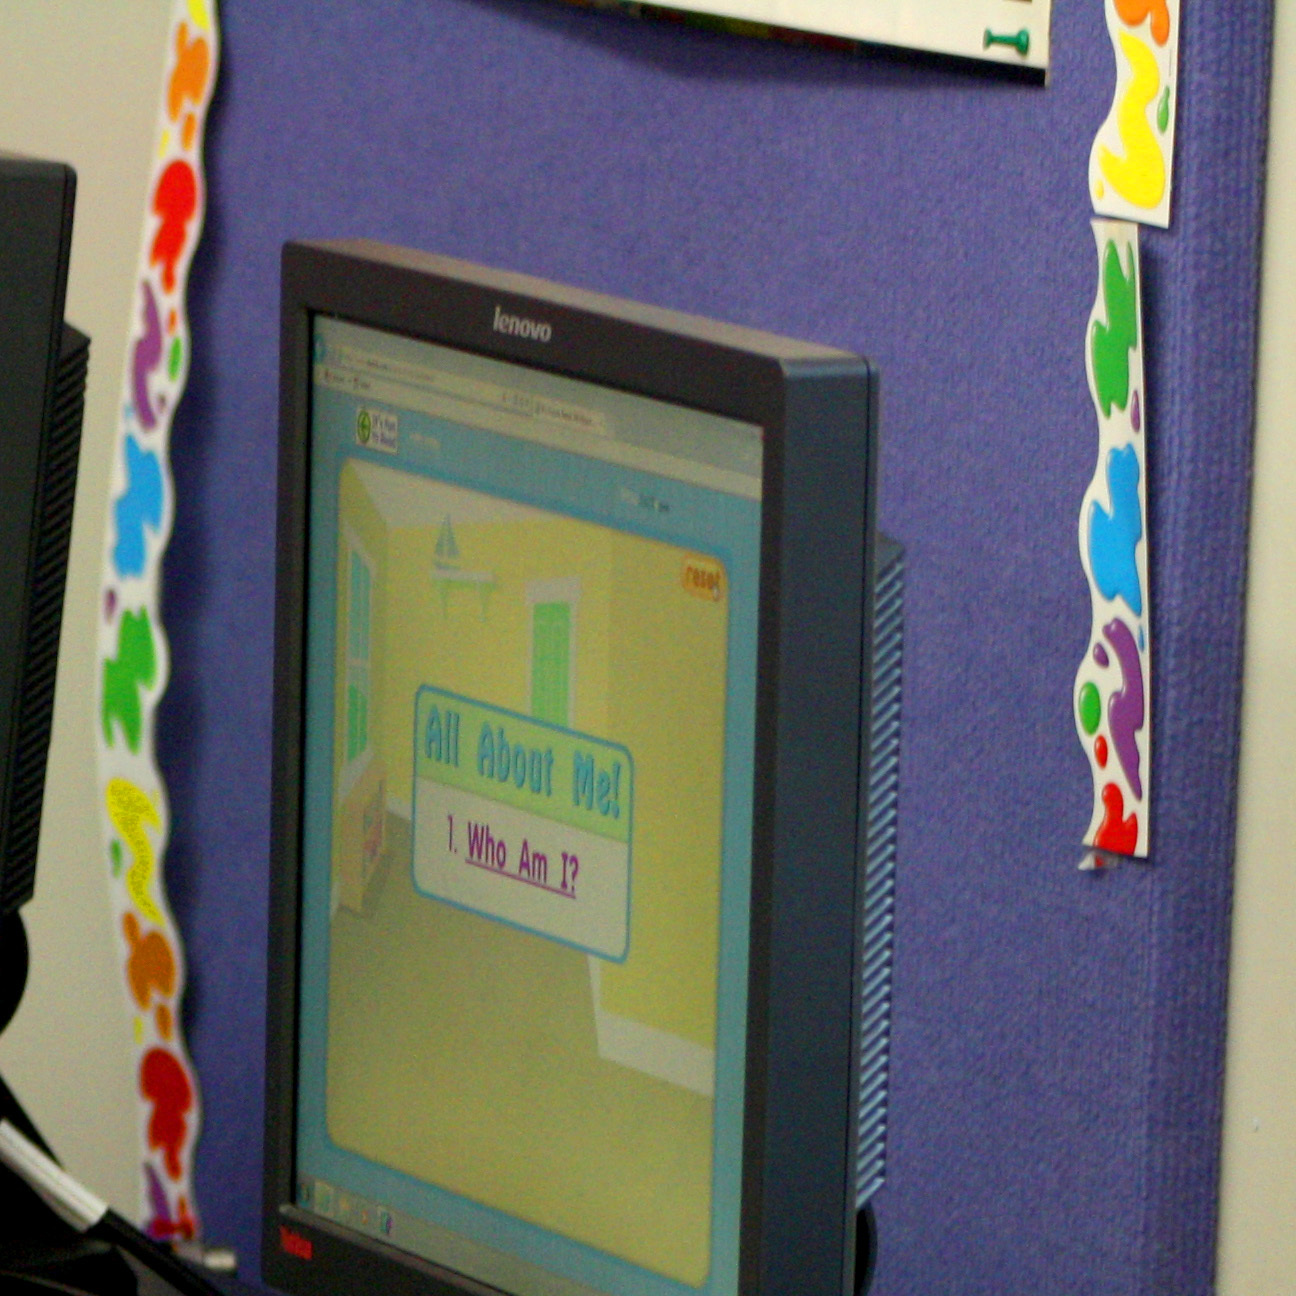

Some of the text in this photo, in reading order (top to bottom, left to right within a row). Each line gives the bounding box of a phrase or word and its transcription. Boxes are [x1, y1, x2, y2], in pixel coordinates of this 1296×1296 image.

[493, 304, 552, 342] lenovo
[424, 703, 622, 820] All About Me!
[446, 814, 580, 895] 1. Who Am I?
